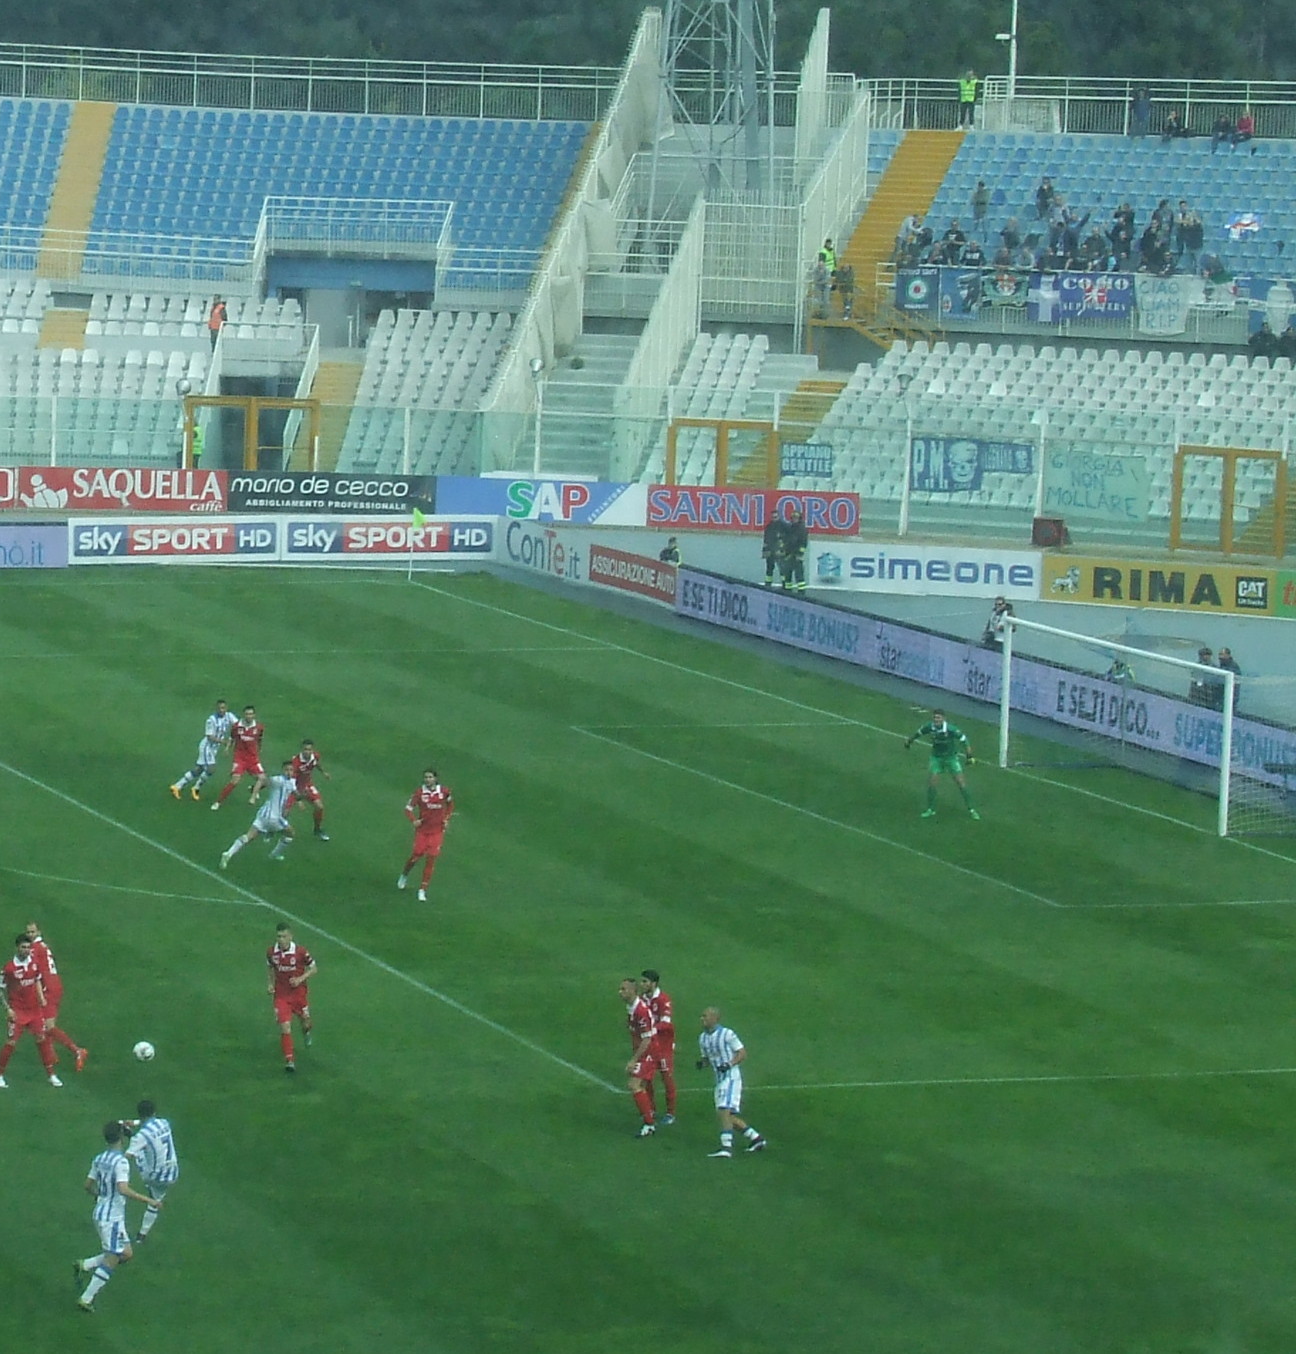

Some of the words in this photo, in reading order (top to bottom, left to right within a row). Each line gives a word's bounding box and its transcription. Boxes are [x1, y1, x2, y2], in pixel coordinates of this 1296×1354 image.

[72, 468, 223, 507] SAQUELLA
[230, 477, 294, 494] mario
[300, 475, 329, 495] de
[335, 480, 410, 498] cecco
[505, 480, 591, 521] SAP
[776, 495, 858, 531] ORO
[78, 526, 122, 555] sky
[133, 527, 229, 551] SPORT
[239, 529, 272, 548] HD
[292, 525, 338, 552] sky
[348, 526, 443, 549] SPORT
[454, 528, 488, 547] HD
[506, 521, 581, 580] ConTe.it
[591, 553, 656, 587] ASSICURAZIONE
[849, 552, 1034, 587] simeone
[1092, 566, 1223, 606] RIMA
[707, 586, 718, 615] TI
[1238, 580, 1266, 598] CAT
